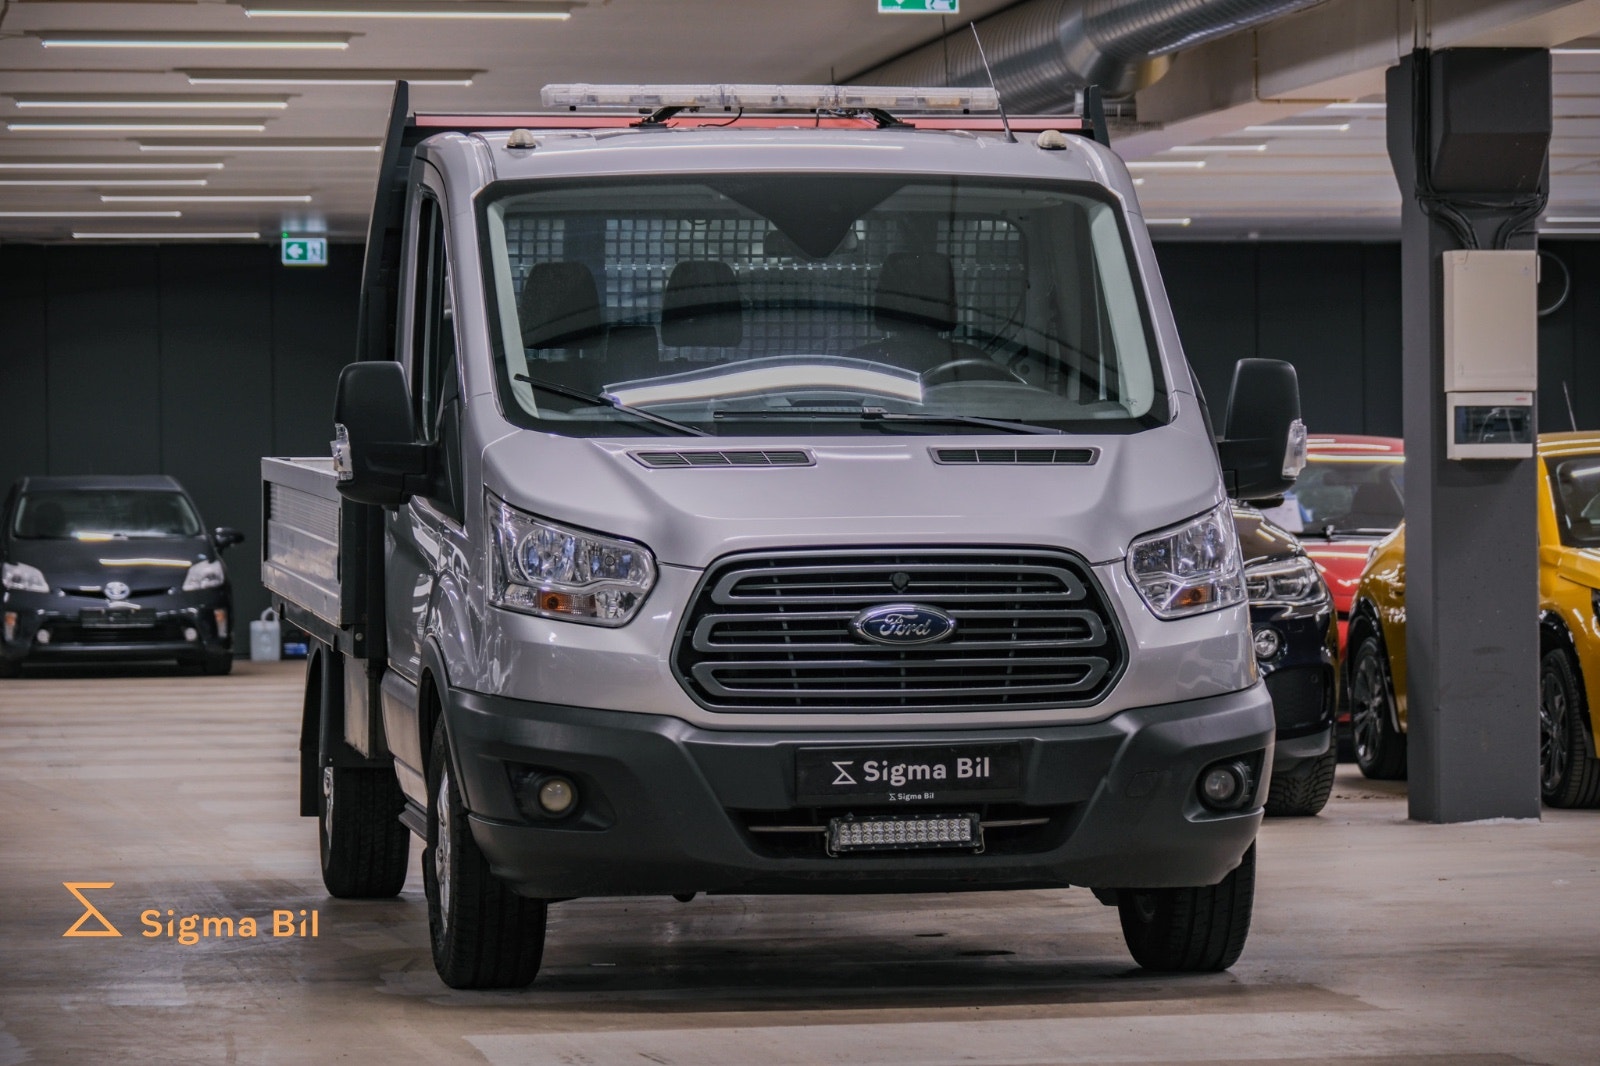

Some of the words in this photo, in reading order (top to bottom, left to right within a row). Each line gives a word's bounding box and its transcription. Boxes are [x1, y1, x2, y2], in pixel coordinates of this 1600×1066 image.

[869, 613, 932, 636] Ford
[863, 760, 947, 786] Sigma
[957, 757, 990, 779] Bil
[897, 793, 922, 801] Sigma
[924, 792, 934, 800] Bil
